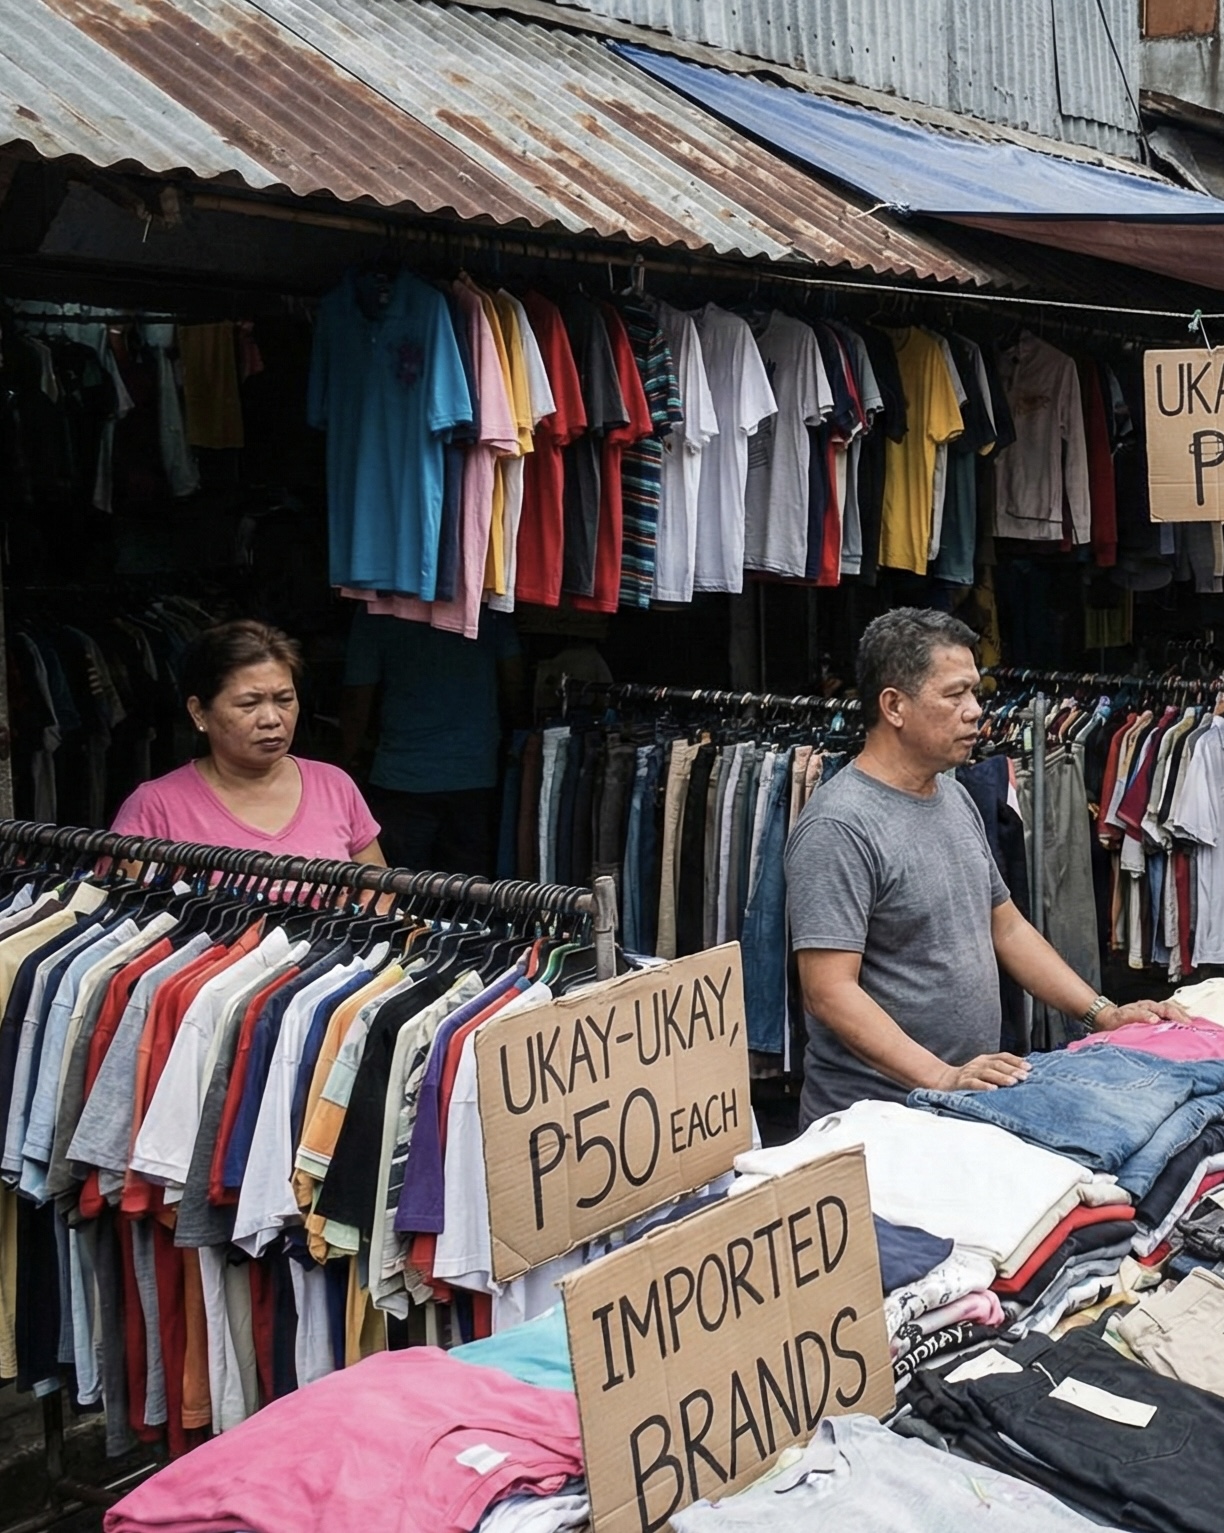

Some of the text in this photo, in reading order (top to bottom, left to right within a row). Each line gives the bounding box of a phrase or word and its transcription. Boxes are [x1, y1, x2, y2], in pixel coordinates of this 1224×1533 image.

[500, 966, 739, 1115] UKAY-UKAY,
[528, 1087, 738, 1231] P50 EACH
[592, 1195, 848, 1391] IMPORTED
[630, 1306, 867, 1533] BRANDS
